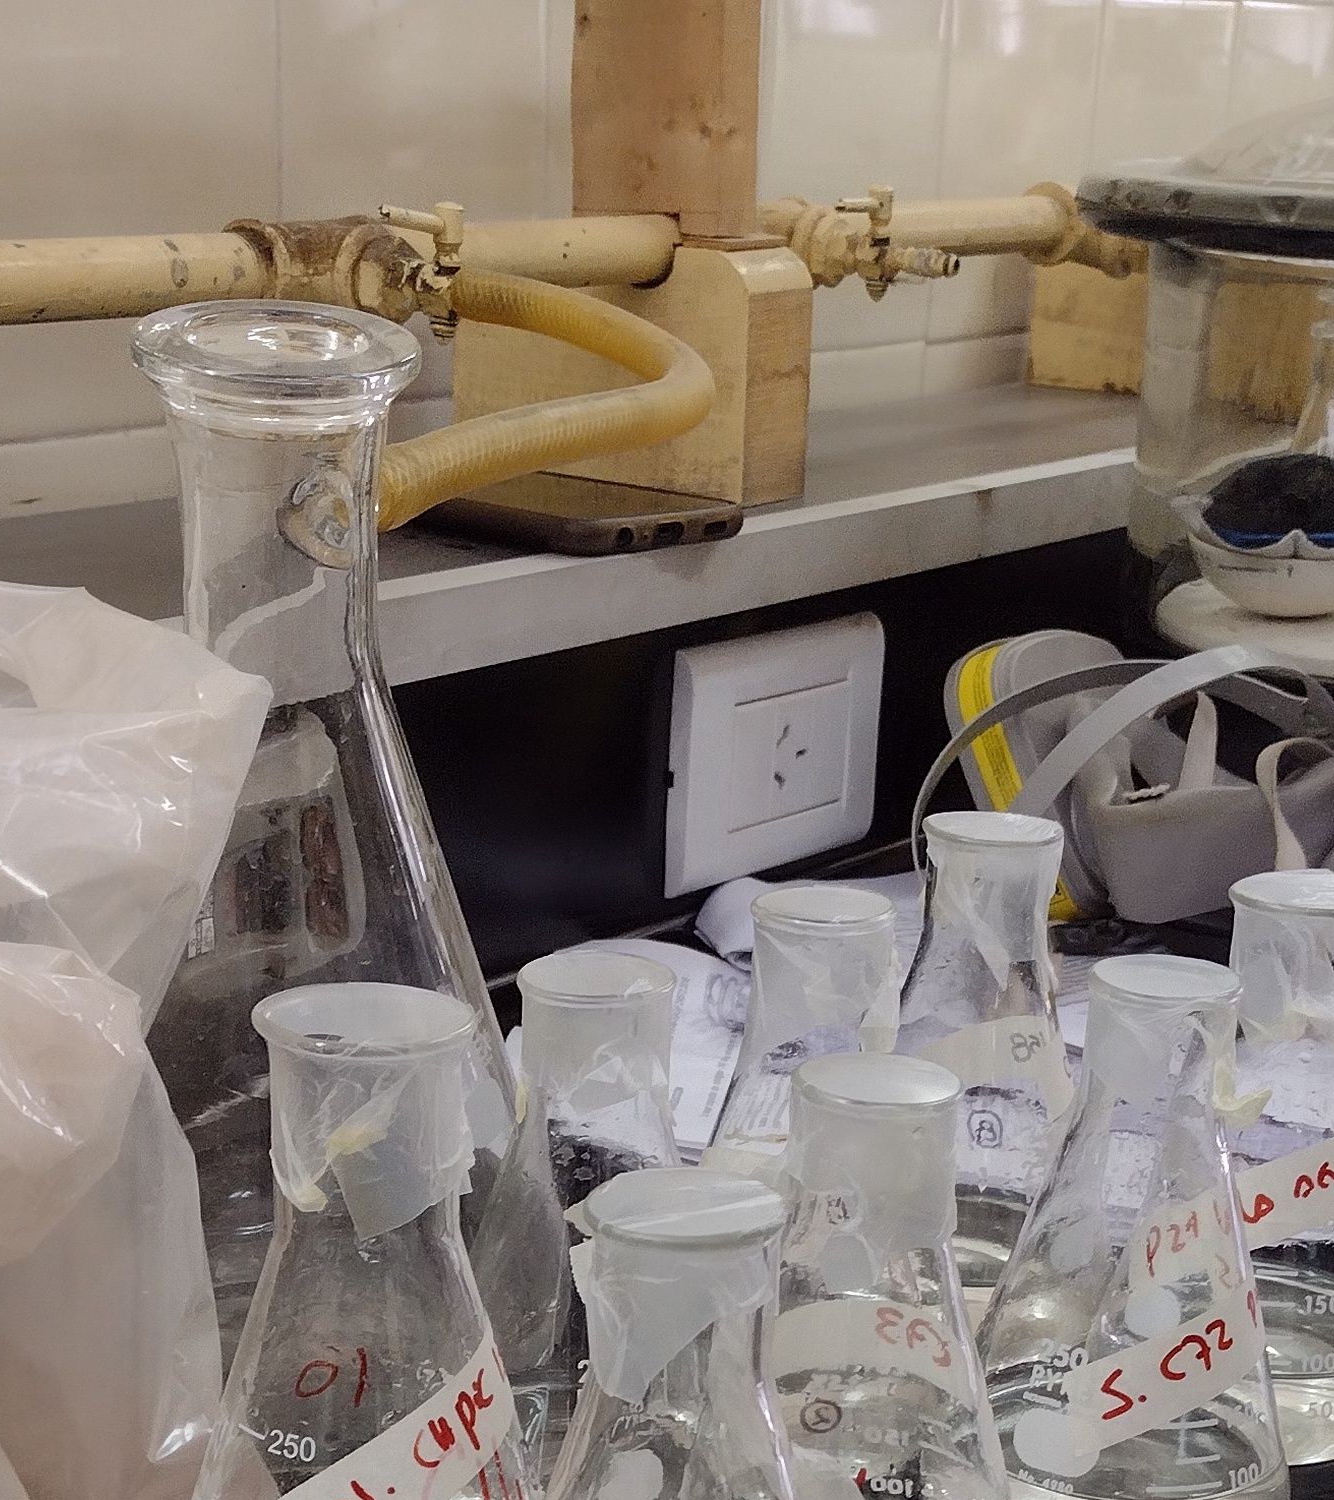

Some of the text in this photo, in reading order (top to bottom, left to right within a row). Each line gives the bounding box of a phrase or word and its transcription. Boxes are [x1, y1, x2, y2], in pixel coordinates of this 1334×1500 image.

[1037, 1338, 1090, 1371] 250
[267, 1429, 317, 1462] 250
[1228, 1463, 1260, 1490] 100
